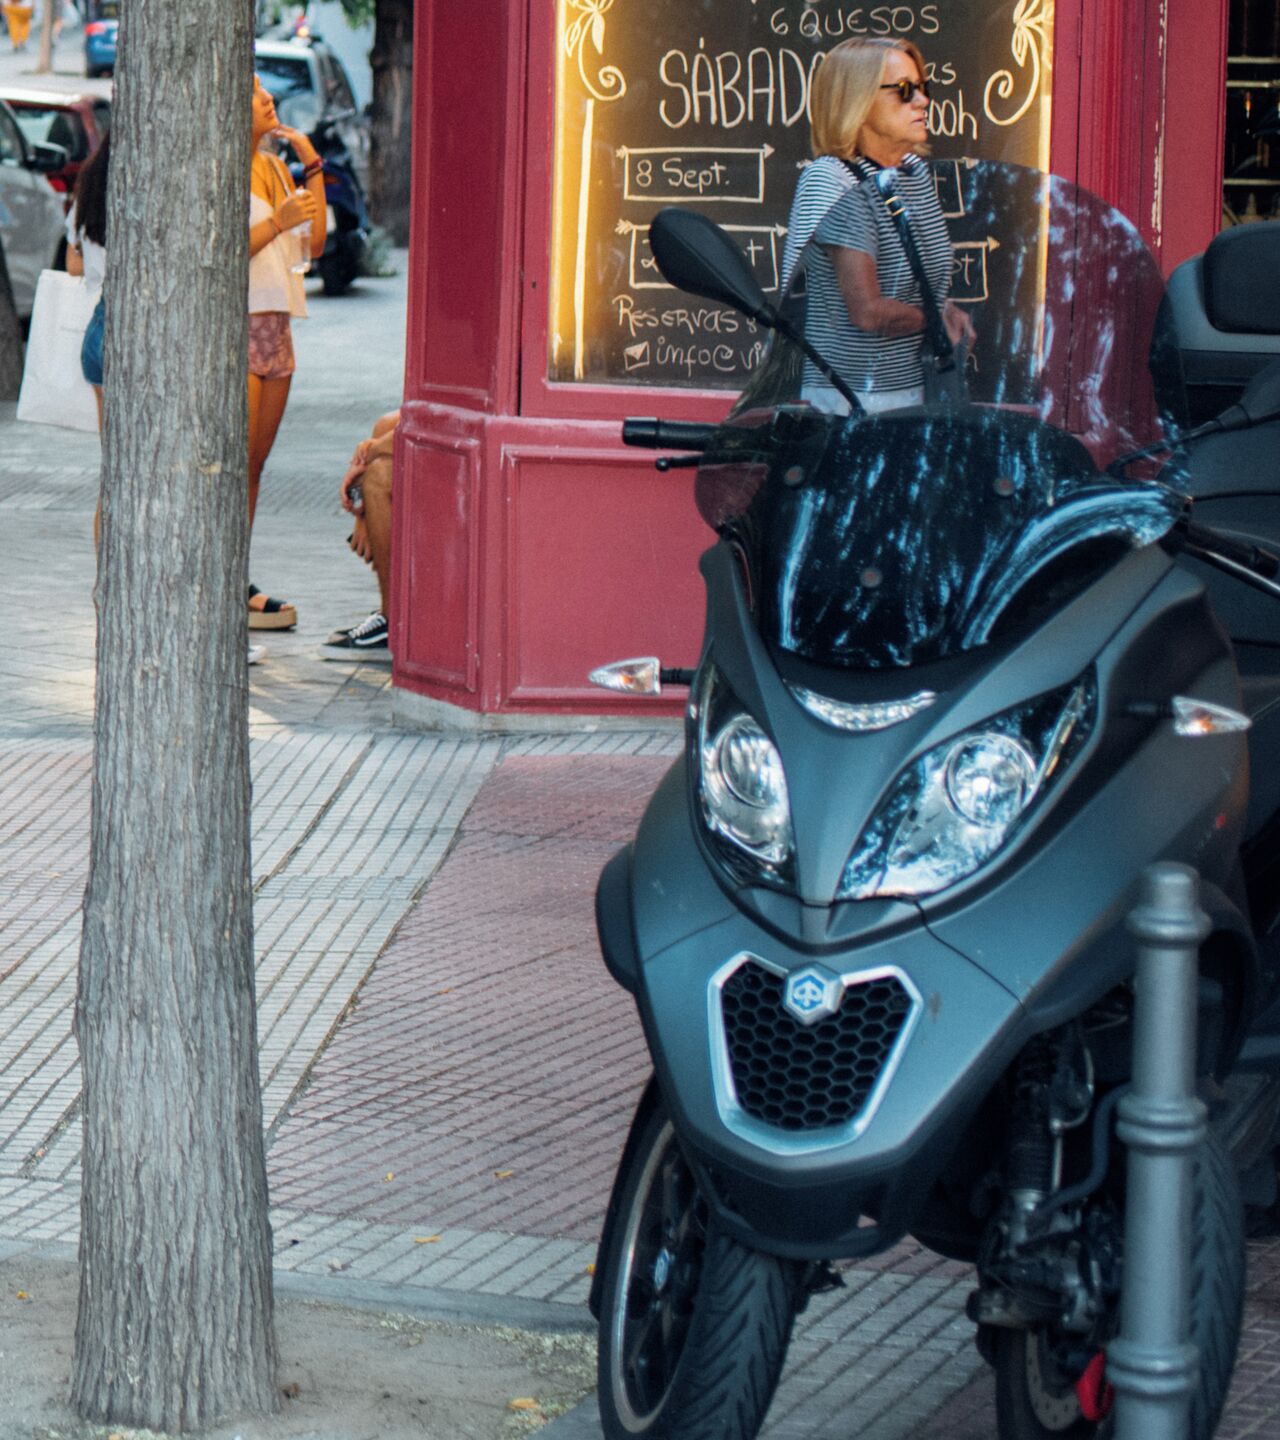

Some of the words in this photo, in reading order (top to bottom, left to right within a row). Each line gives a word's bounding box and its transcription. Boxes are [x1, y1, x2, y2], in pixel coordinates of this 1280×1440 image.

[769, 7, 790, 36] 6
[799, 5, 940, 39] QUESOS
[635, 159, 654, 188] 8
[661, 157, 731, 195] Sept.
